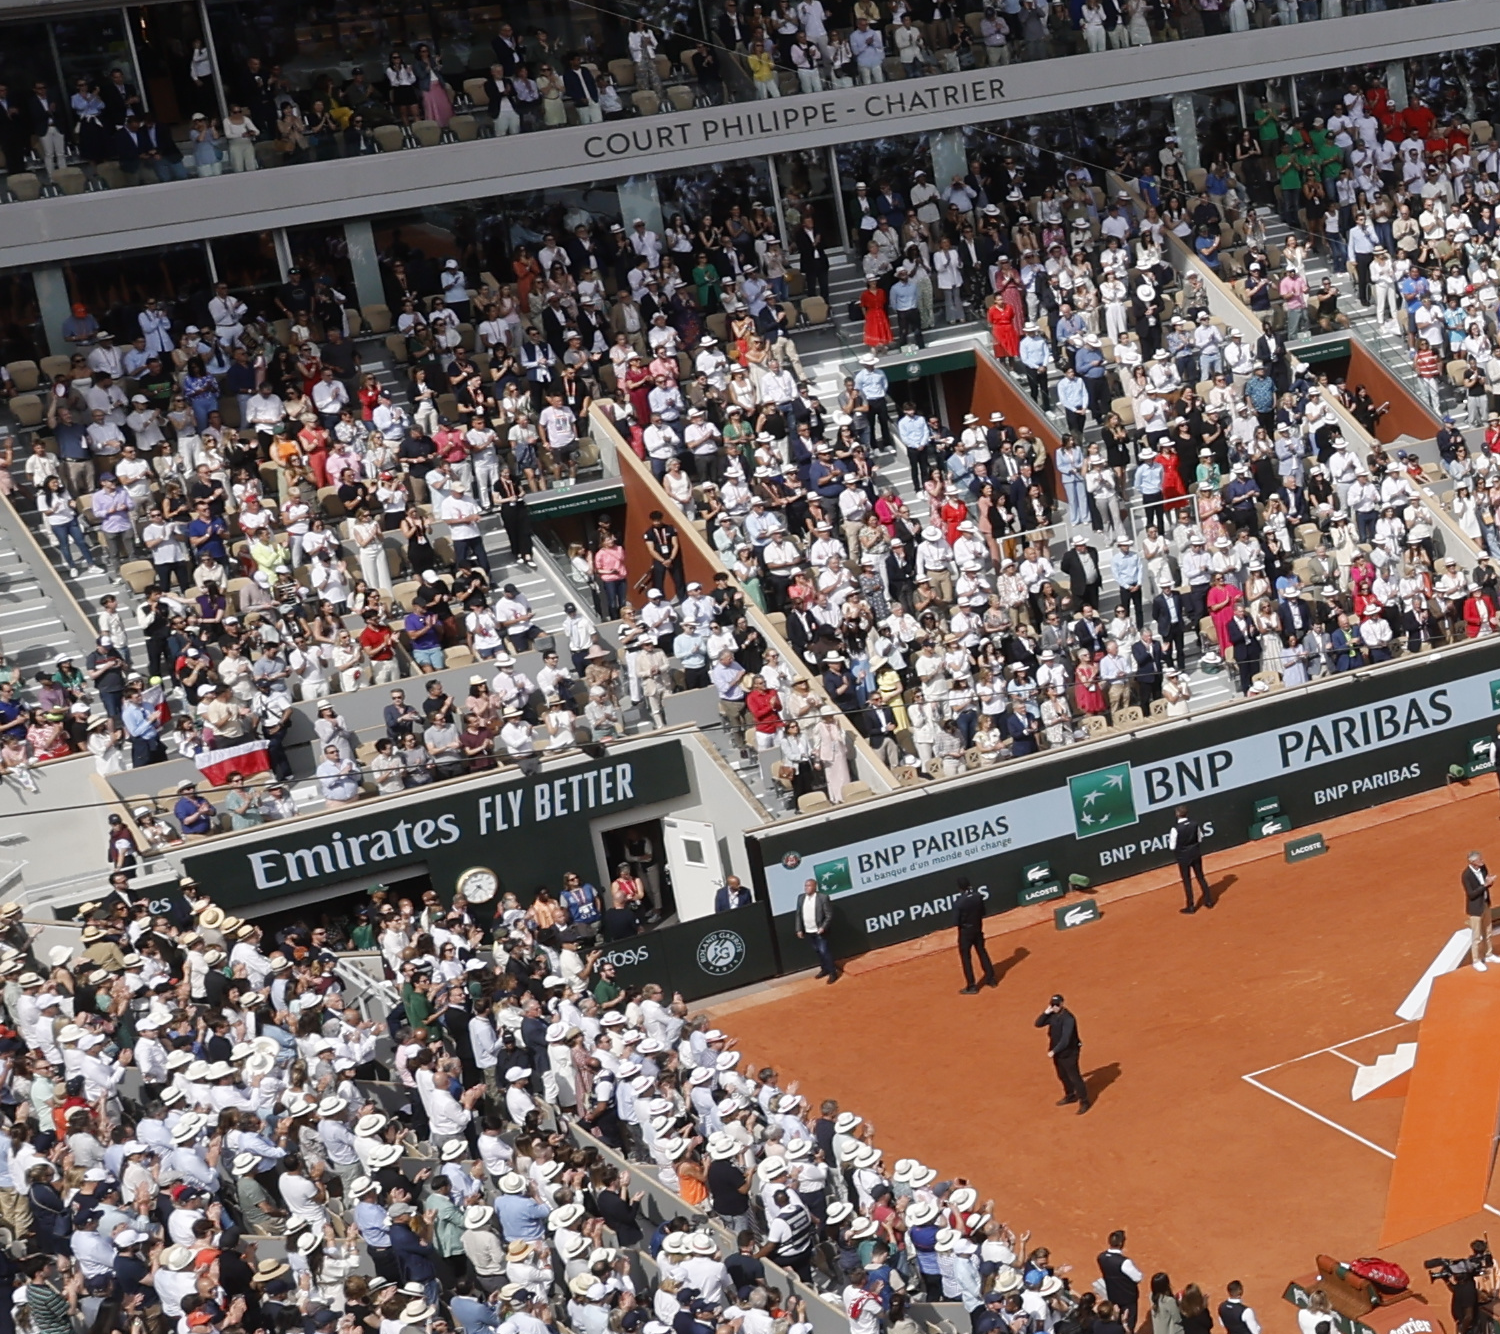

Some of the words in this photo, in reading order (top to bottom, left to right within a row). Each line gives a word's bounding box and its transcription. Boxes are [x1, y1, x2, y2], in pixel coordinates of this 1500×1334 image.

[583, 122, 691, 158] COURT
[703, 102, 837, 142] PHILIPPE
[864, 78, 1006, 117] CHATRIER
[1143, 750, 1234, 805] BNP
[1278, 689, 1453, 768] PARIBAS
[1470, 760, 1495, 772] LACOST
[1313, 783, 1350, 806] BNP
[1352, 762, 1421, 795] PARIBAS
[246, 813, 460, 890] Emirates
[478, 788, 524, 836] FLY
[534, 762, 634, 822] BETTER
[857, 844, 906, 875] BNP
[912, 815, 1010, 859] PARIBAS
[1099, 842, 1137, 867] BNP
[1140, 821, 1214, 856] PARS
[1291, 841, 1322, 857] LACOSTE
[860, 874, 873, 885] La
[874, 865, 908, 881] banque
[931, 850, 963, 867] monde
[981, 836, 1013, 852] change
[865, 909, 906, 934] BNP
[909, 885, 990, 922] PARIS
[1025, 884, 1059, 901] LACOSTE
[699, 934, 718, 964] ROLAND
[719, 931, 743, 953] GARROS
